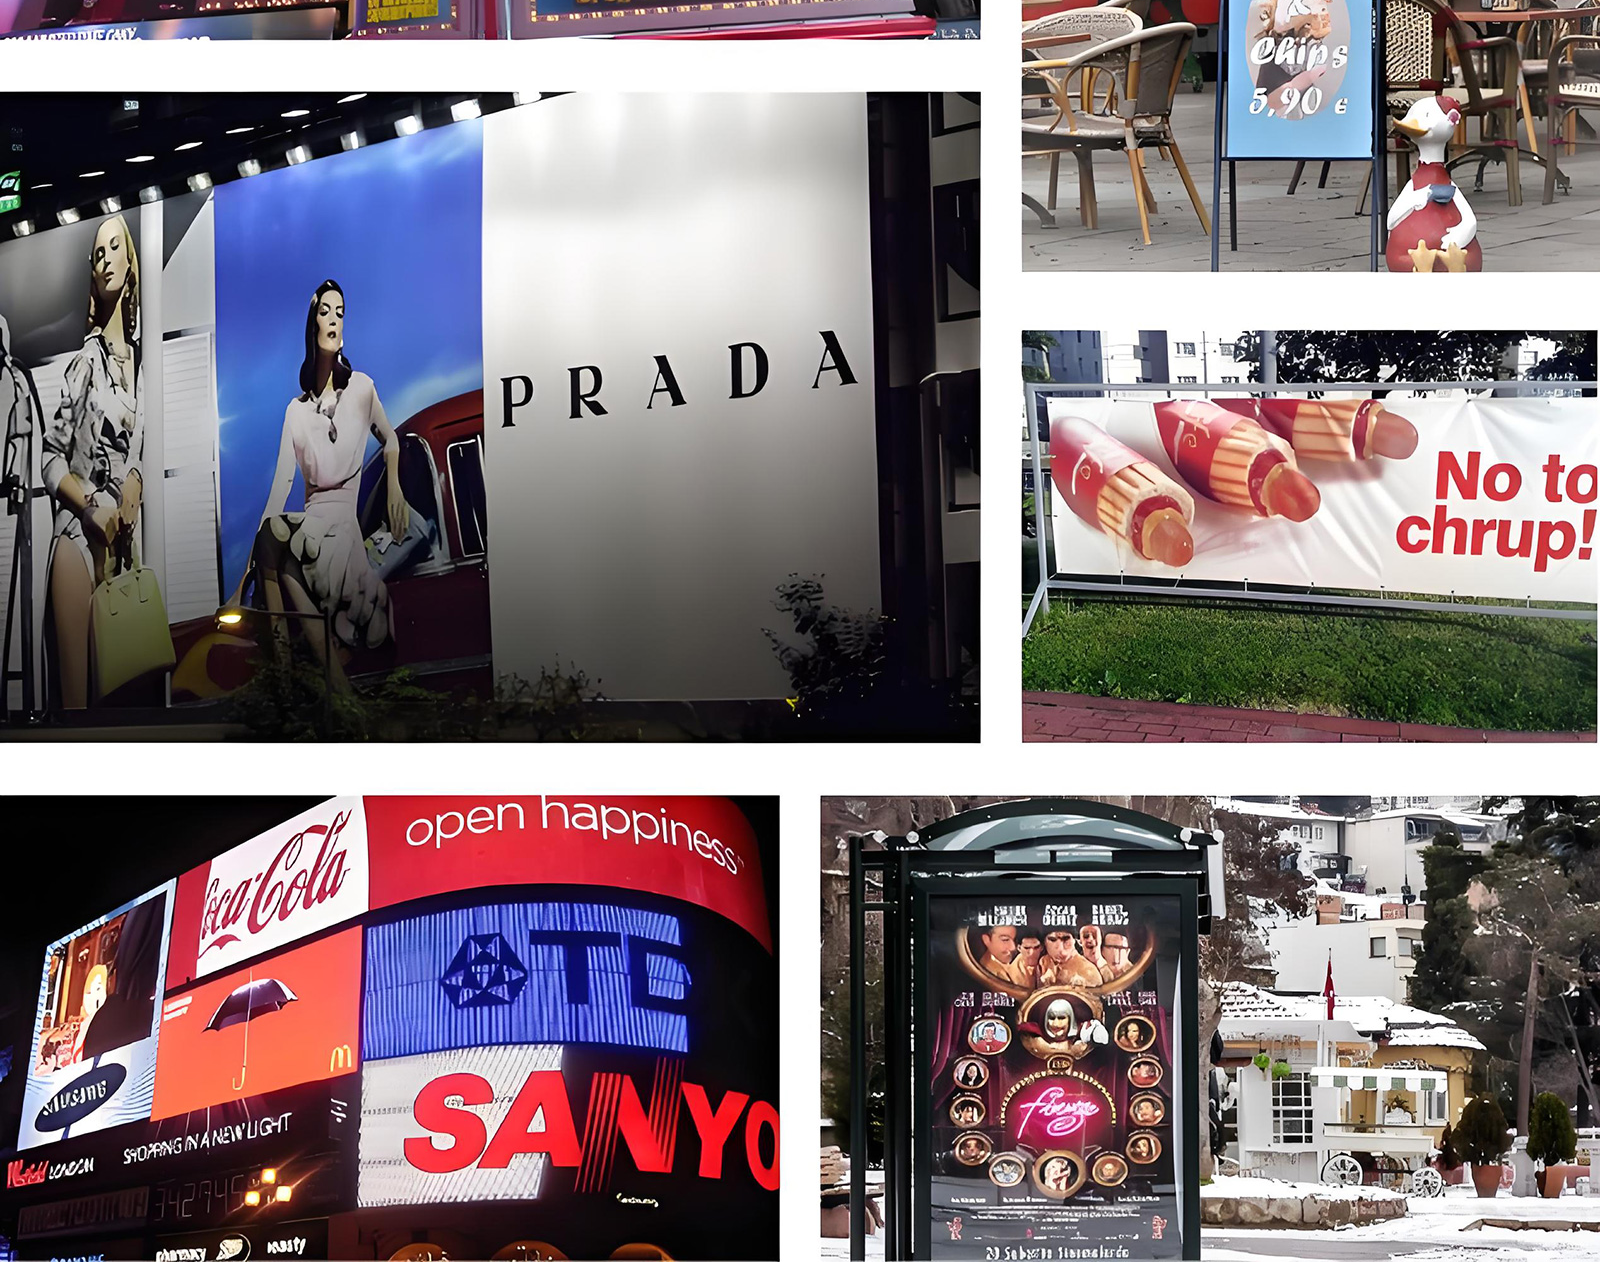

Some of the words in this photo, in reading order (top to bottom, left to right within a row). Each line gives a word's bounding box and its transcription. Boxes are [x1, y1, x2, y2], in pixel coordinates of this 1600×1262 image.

[1250, 36, 1349, 72] Chips
[500, 329, 859, 429] PRADA
[1435, 450, 1523, 502] No
[1541, 453, 1598, 504] to
[1395, 504, 1598, 573] chrup!
[405, 802, 525, 849] open
[540, 795, 738, 875] happiness
[184, 1133, 200, 1152] IN
[200, 1131, 211, 1149] A
[402, 1068, 781, 1192] SANYO
